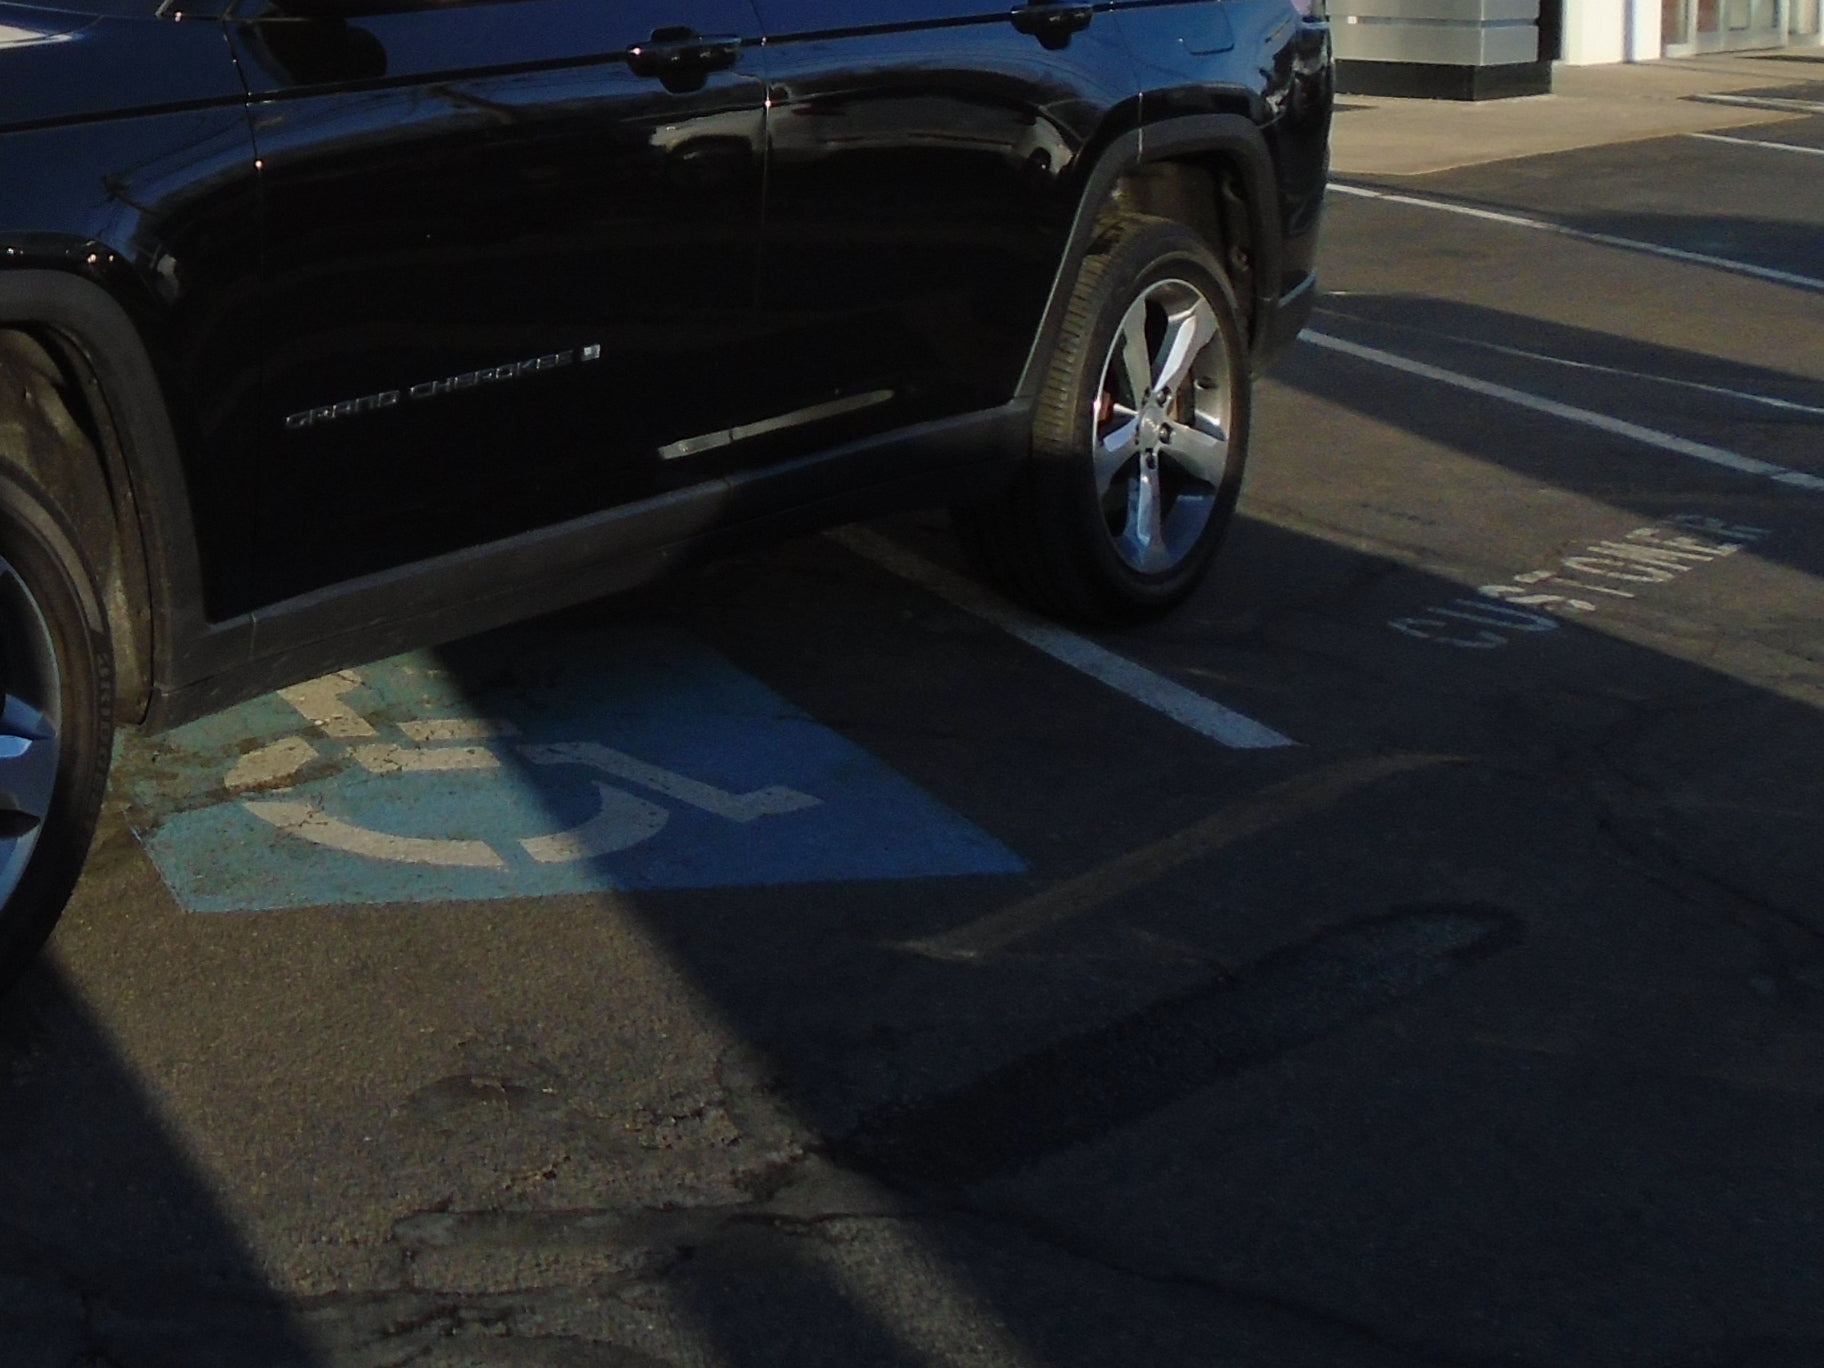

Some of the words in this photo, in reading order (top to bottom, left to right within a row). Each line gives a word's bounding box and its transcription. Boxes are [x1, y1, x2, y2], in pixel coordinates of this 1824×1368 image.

[285, 389, 400, 429] GRAND
[410, 349, 574, 401] CHEROKEE
[1387, 514, 1775, 650] CUSTOMER
